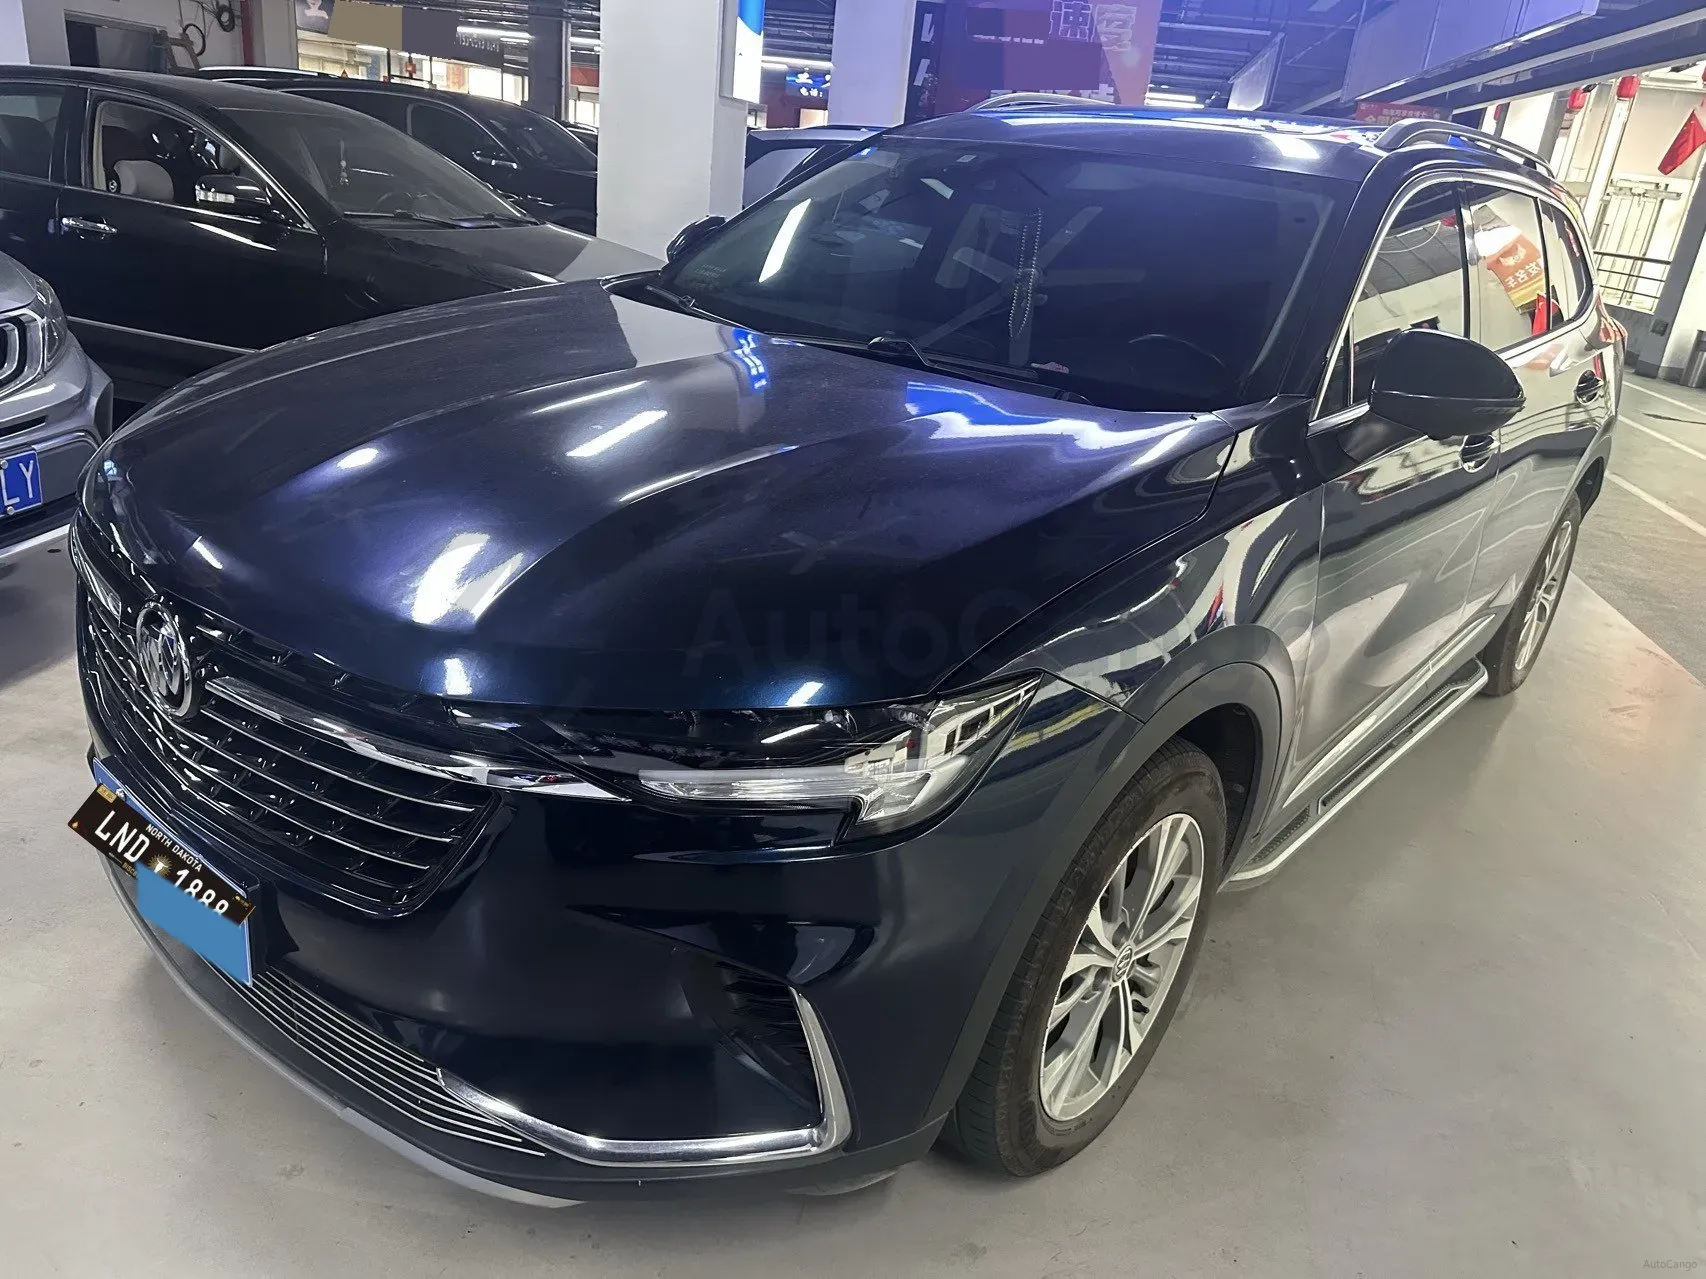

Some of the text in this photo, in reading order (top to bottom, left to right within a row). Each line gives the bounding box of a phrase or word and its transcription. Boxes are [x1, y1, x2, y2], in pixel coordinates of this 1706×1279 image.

[94, 810, 150, 863] LND
[145, 823, 203, 873] NORTH DAKOTA
